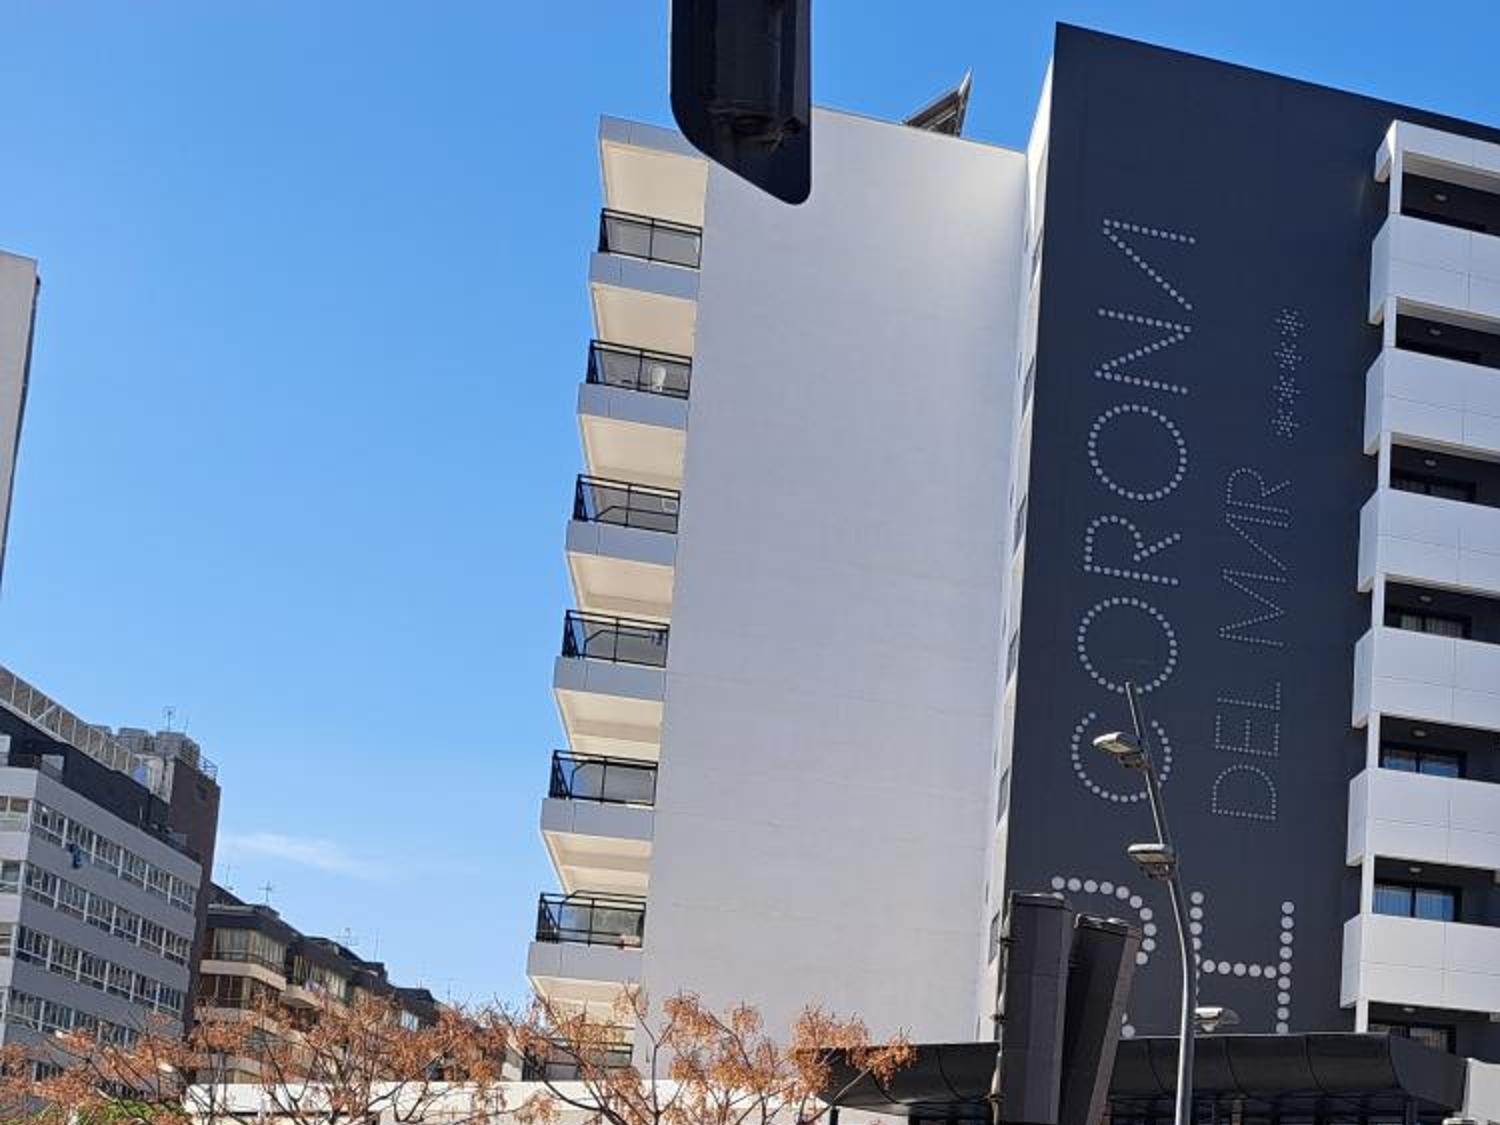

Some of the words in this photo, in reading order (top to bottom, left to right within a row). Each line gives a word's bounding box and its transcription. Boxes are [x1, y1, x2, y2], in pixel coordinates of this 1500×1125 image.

[1071, 219, 1195, 804] CORONA
[1218, 467, 1292, 647] MAR
[1212, 682, 1282, 821] DEL
